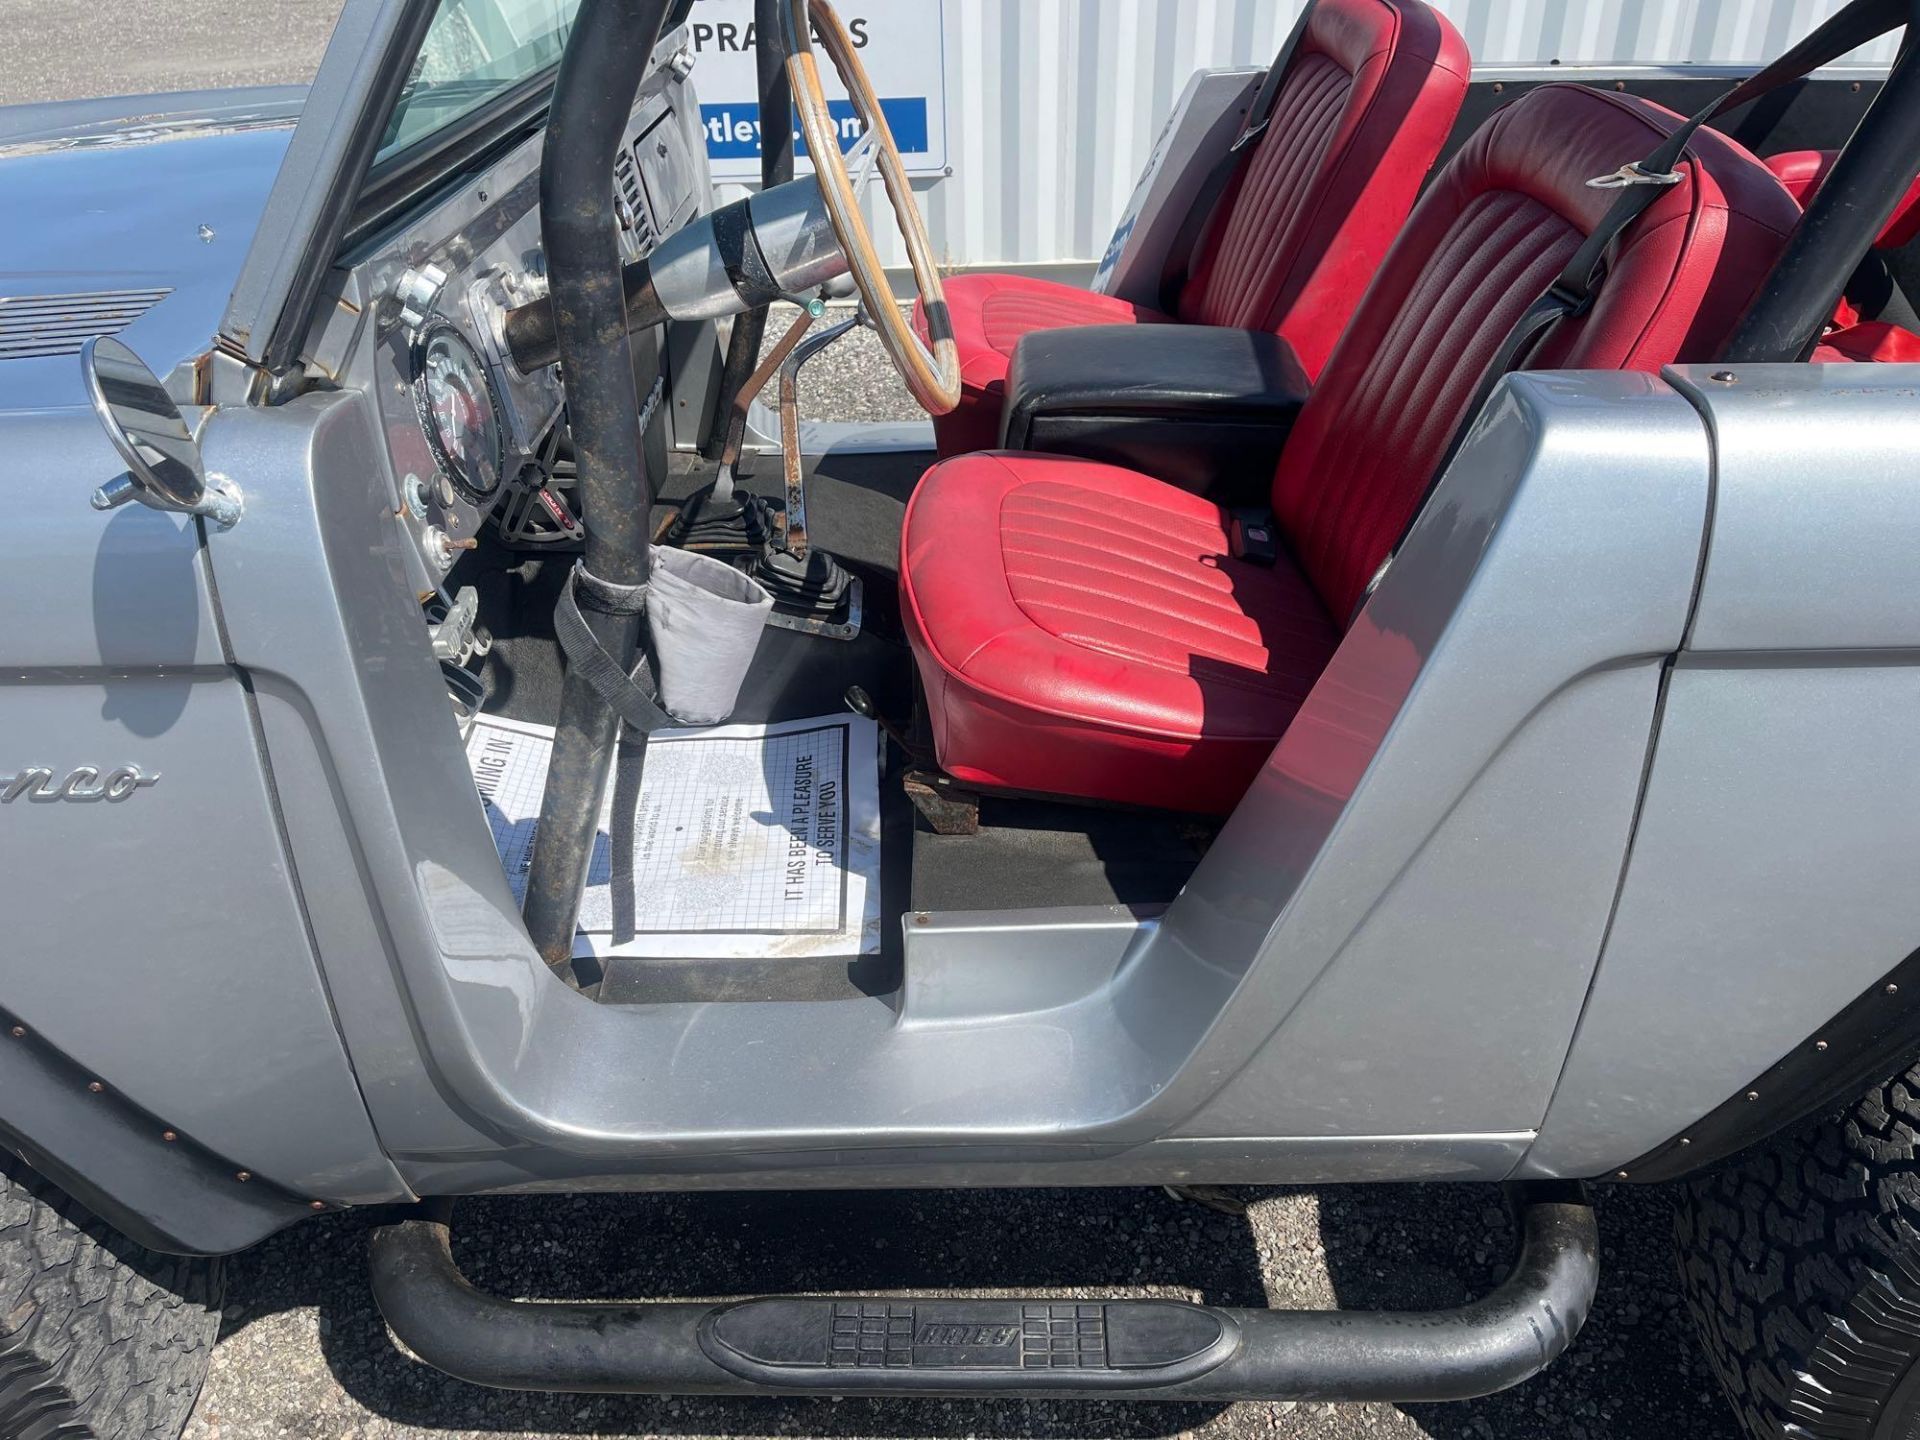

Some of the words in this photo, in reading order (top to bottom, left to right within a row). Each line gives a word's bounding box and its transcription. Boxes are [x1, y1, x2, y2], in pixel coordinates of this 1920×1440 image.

[485, 737, 514, 755] IN
[0, 763, 161, 803] nco
[792, 754, 813, 815] PLEASURE
[818, 780, 836, 811] YOU
[791, 815, 809, 827] A
[816, 811, 837, 848] SERVE
[788, 827, 808, 858] BEEN
[786, 860, 806, 885] HAS
[815, 850, 835, 867] TO
[784, 888, 804, 901] IT
